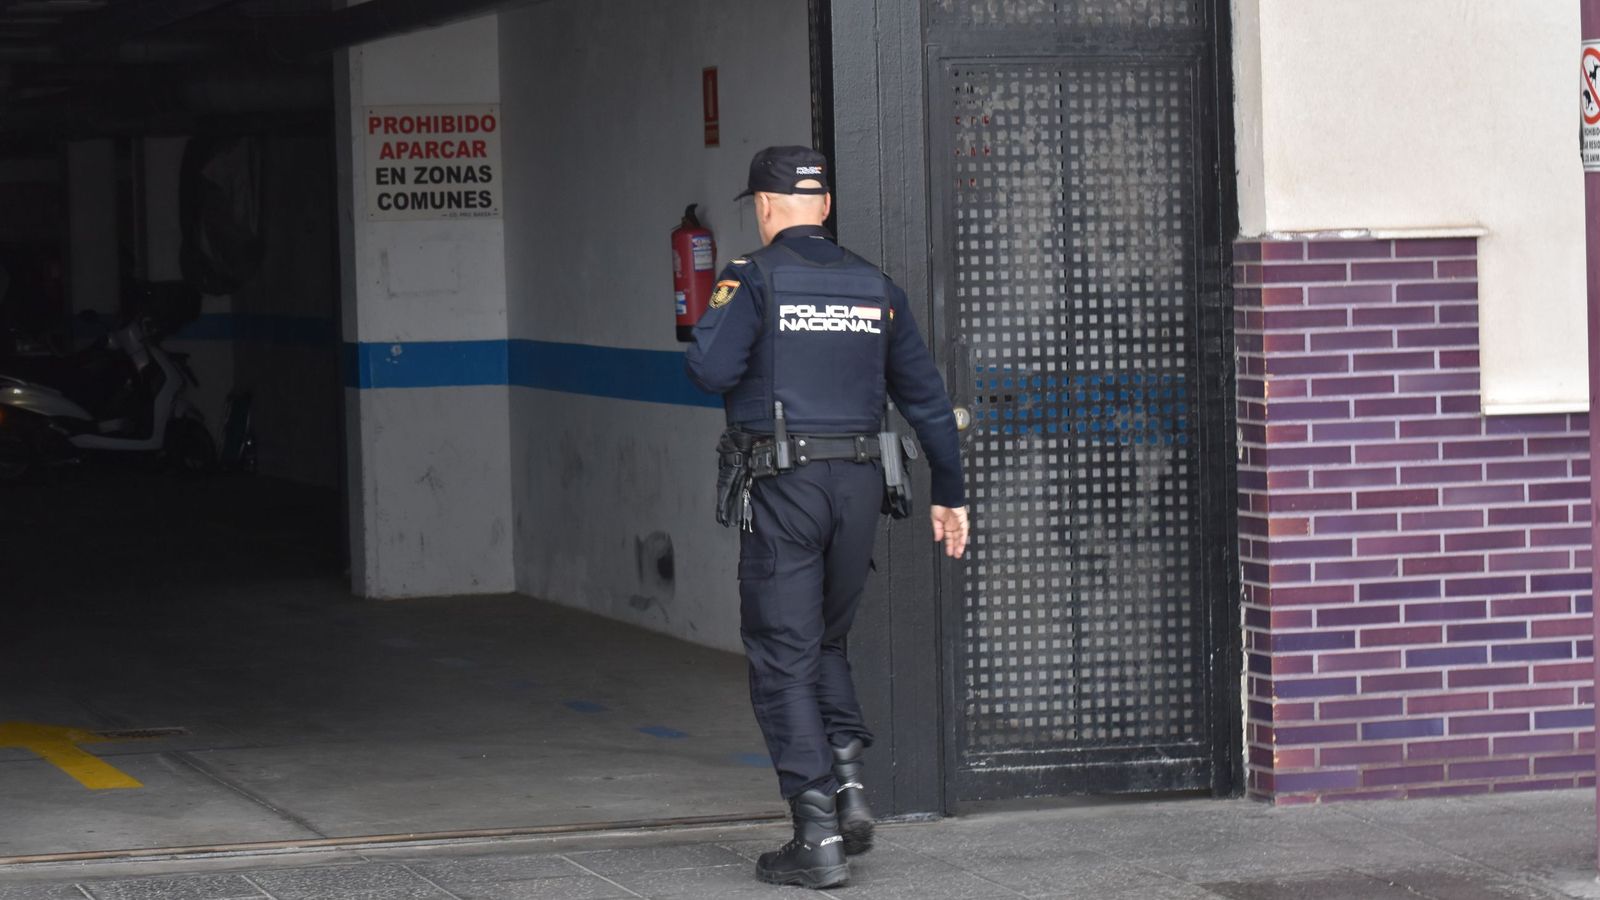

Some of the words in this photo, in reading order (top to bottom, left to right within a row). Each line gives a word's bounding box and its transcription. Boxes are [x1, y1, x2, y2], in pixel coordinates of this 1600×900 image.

[369, 115, 496, 134] PROHIBIDO
[380, 140, 487, 160] APARCAR
[376, 167, 405, 185] EN
[414, 165, 493, 184] ZONAS
[377, 191, 492, 210] COMUNES
[780, 305, 860, 318] POLICIA
[780, 318, 880, 333] NACIONAL
